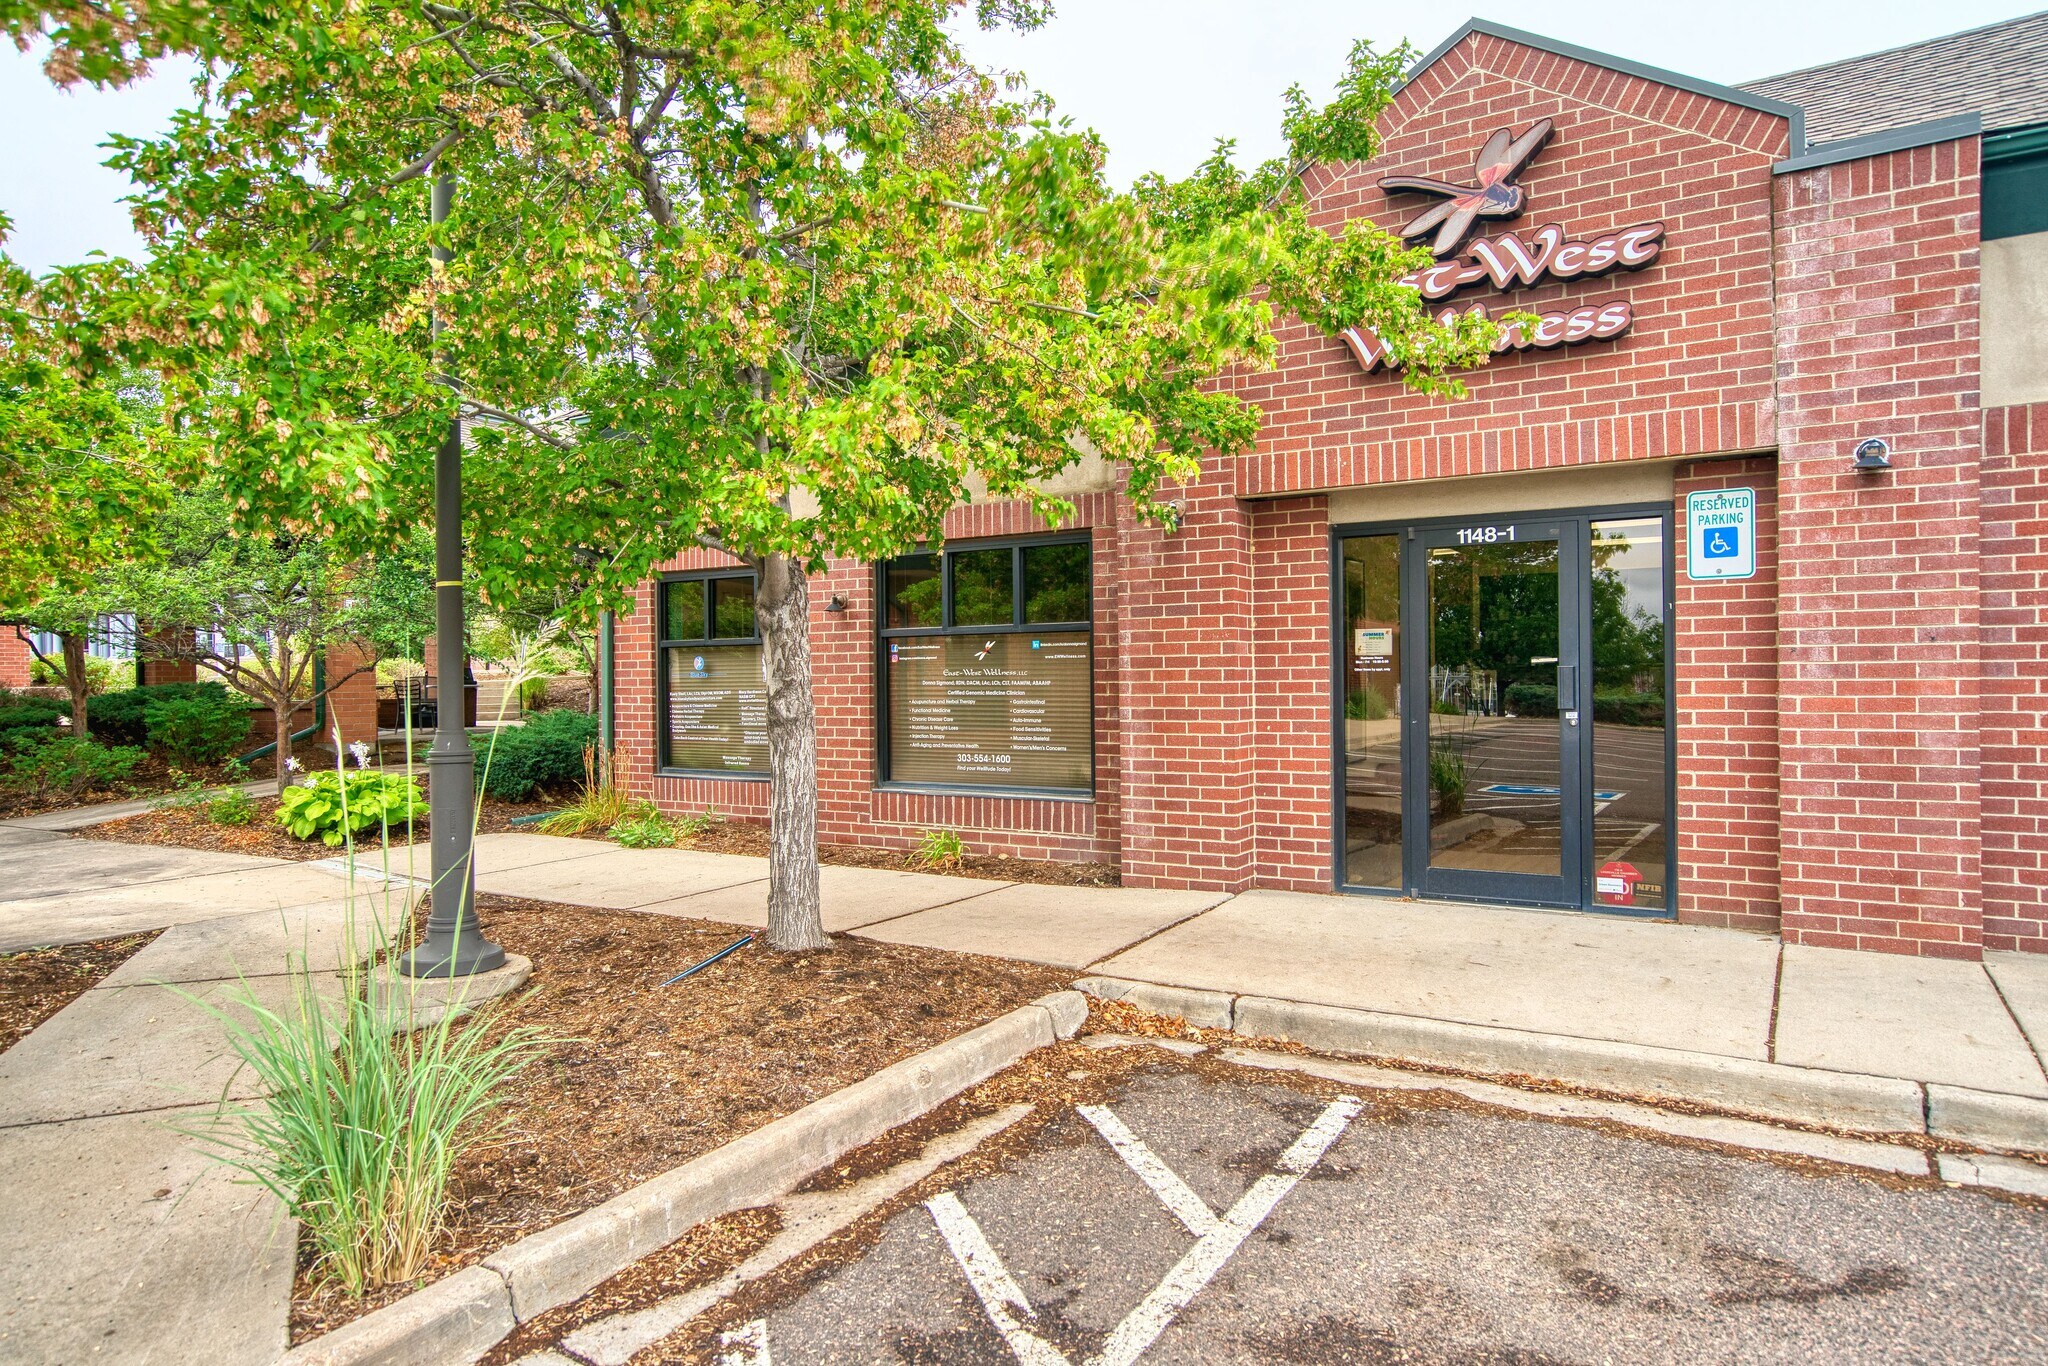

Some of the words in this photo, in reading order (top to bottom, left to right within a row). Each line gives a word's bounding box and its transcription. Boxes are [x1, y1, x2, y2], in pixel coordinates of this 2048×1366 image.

[1692, 497, 1749, 511] RESERVED
[1698, 513, 1744, 526] PARKING
[1456, 526, 1515, 544] 1148-1
[1637, 883, 1662, 892] NFIB
